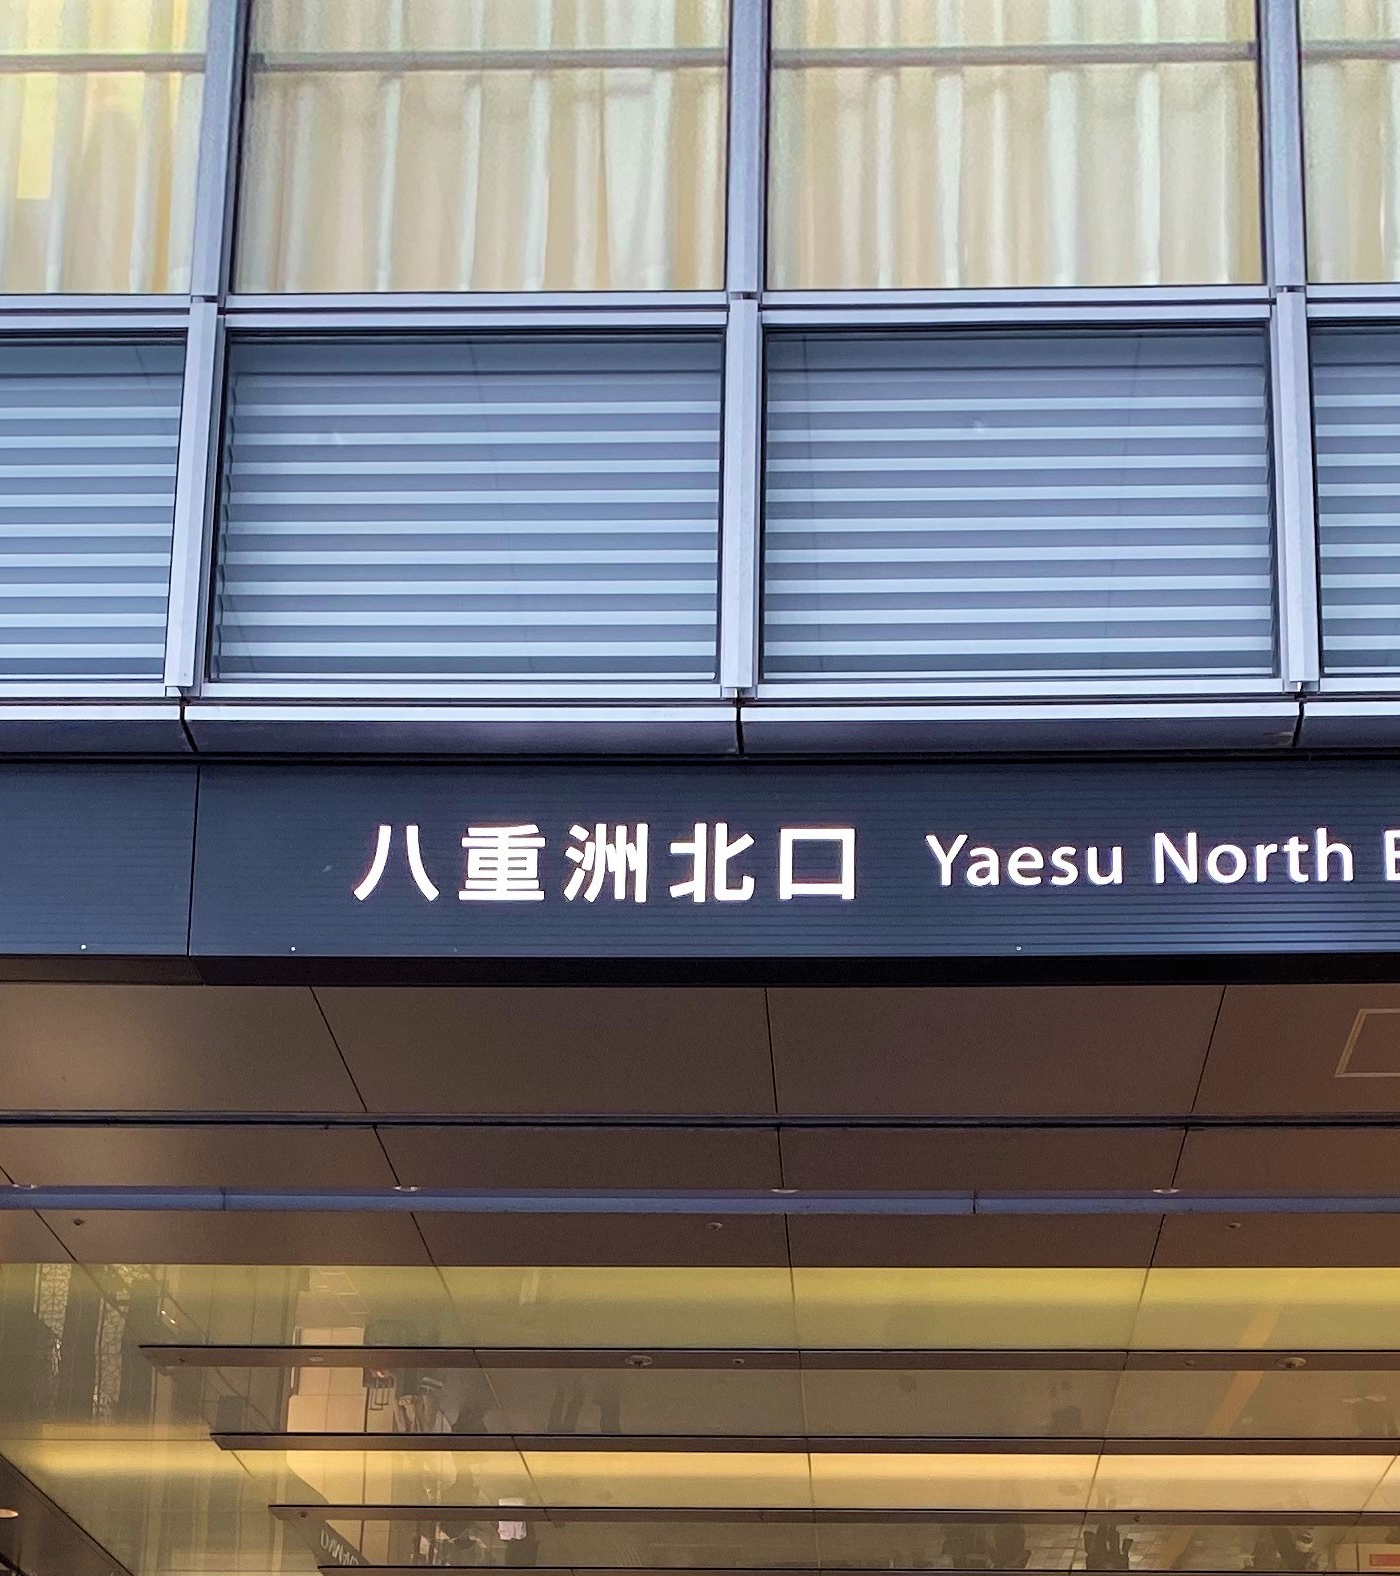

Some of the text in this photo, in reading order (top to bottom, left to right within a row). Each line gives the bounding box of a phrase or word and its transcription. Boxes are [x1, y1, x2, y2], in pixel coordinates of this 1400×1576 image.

[353, 822, 857, 904] 八重洲北口
[924, 833, 1124, 886] Yaesu
[1153, 828, 1354, 884] North
